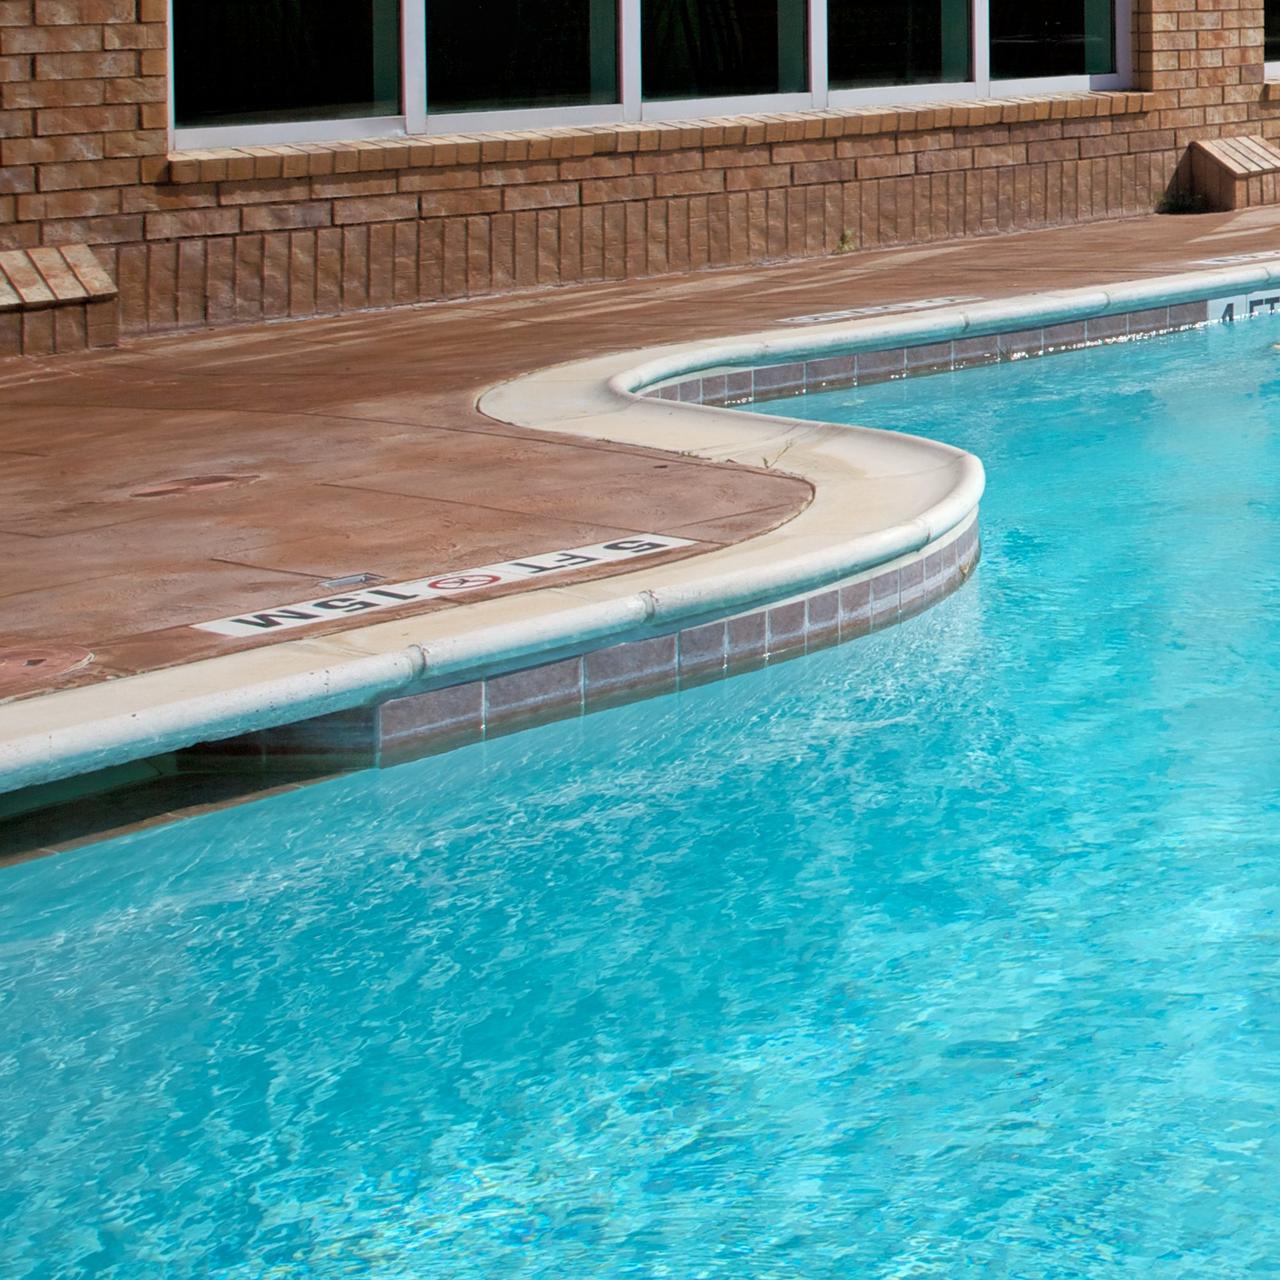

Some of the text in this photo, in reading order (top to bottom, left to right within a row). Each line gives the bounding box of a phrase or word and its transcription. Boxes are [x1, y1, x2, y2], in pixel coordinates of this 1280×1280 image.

[603, 540, 669, 553] 5
[510, 552, 599, 574] FT
[231, 609, 322, 629] M
